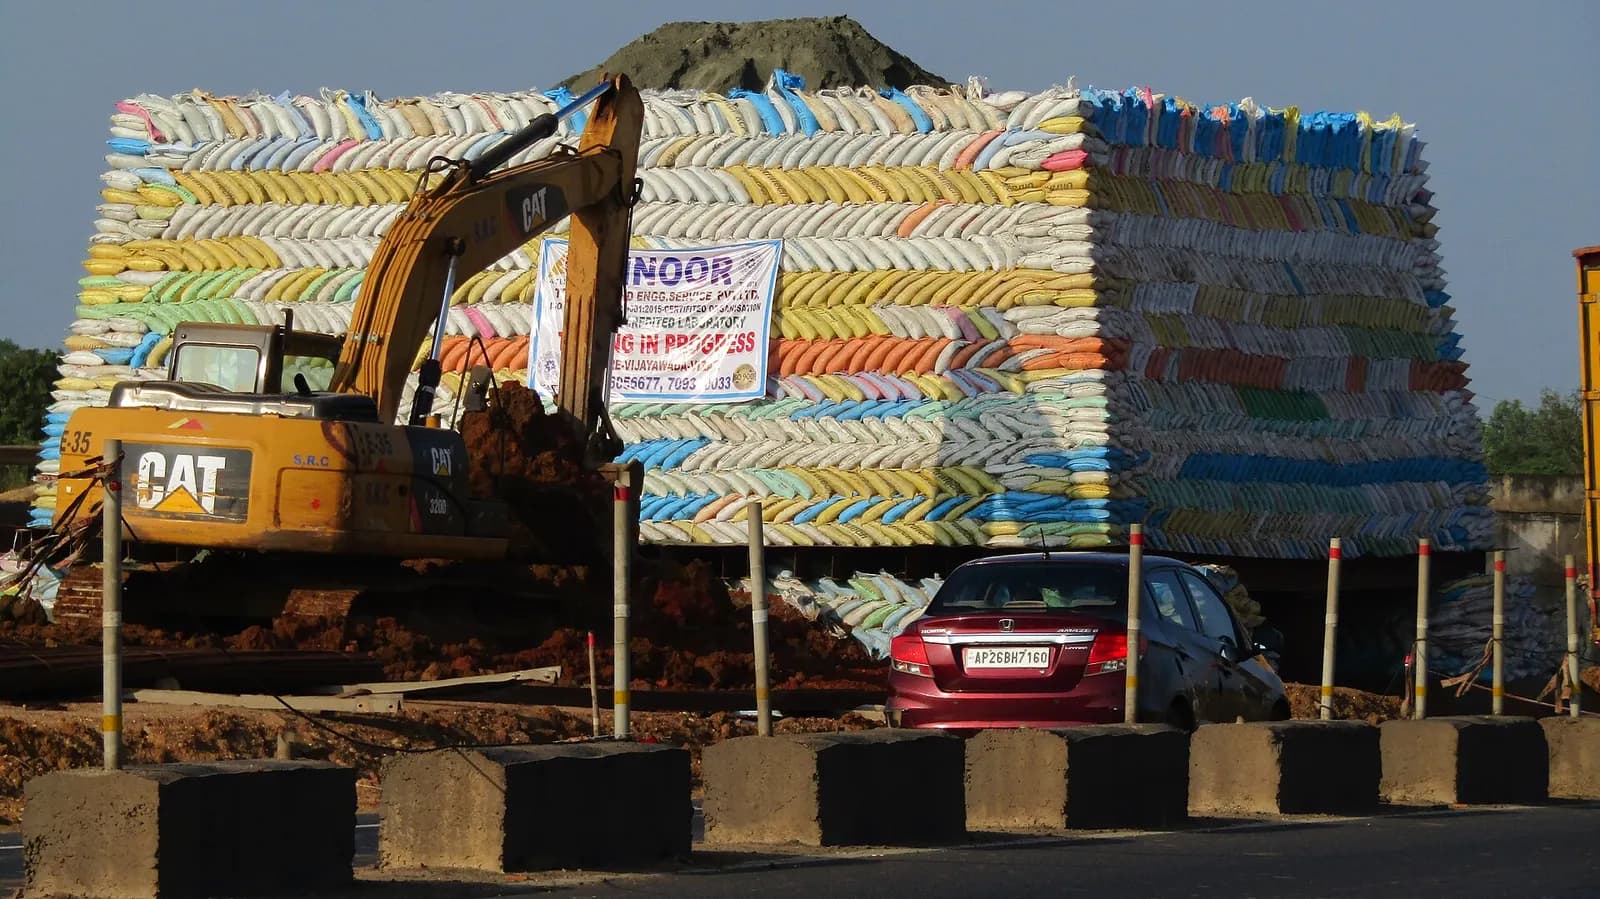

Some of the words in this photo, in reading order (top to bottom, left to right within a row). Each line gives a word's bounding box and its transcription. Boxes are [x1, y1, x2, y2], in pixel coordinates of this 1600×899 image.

[522, 187, 546, 232] CAT
[640, 333, 659, 354] IN
[293, 453, 330, 467] S.R.C
[431, 447, 452, 477] CAT
[136, 451, 226, 515] CAT
[974, 651, 1047, 665] AP26BH7160
